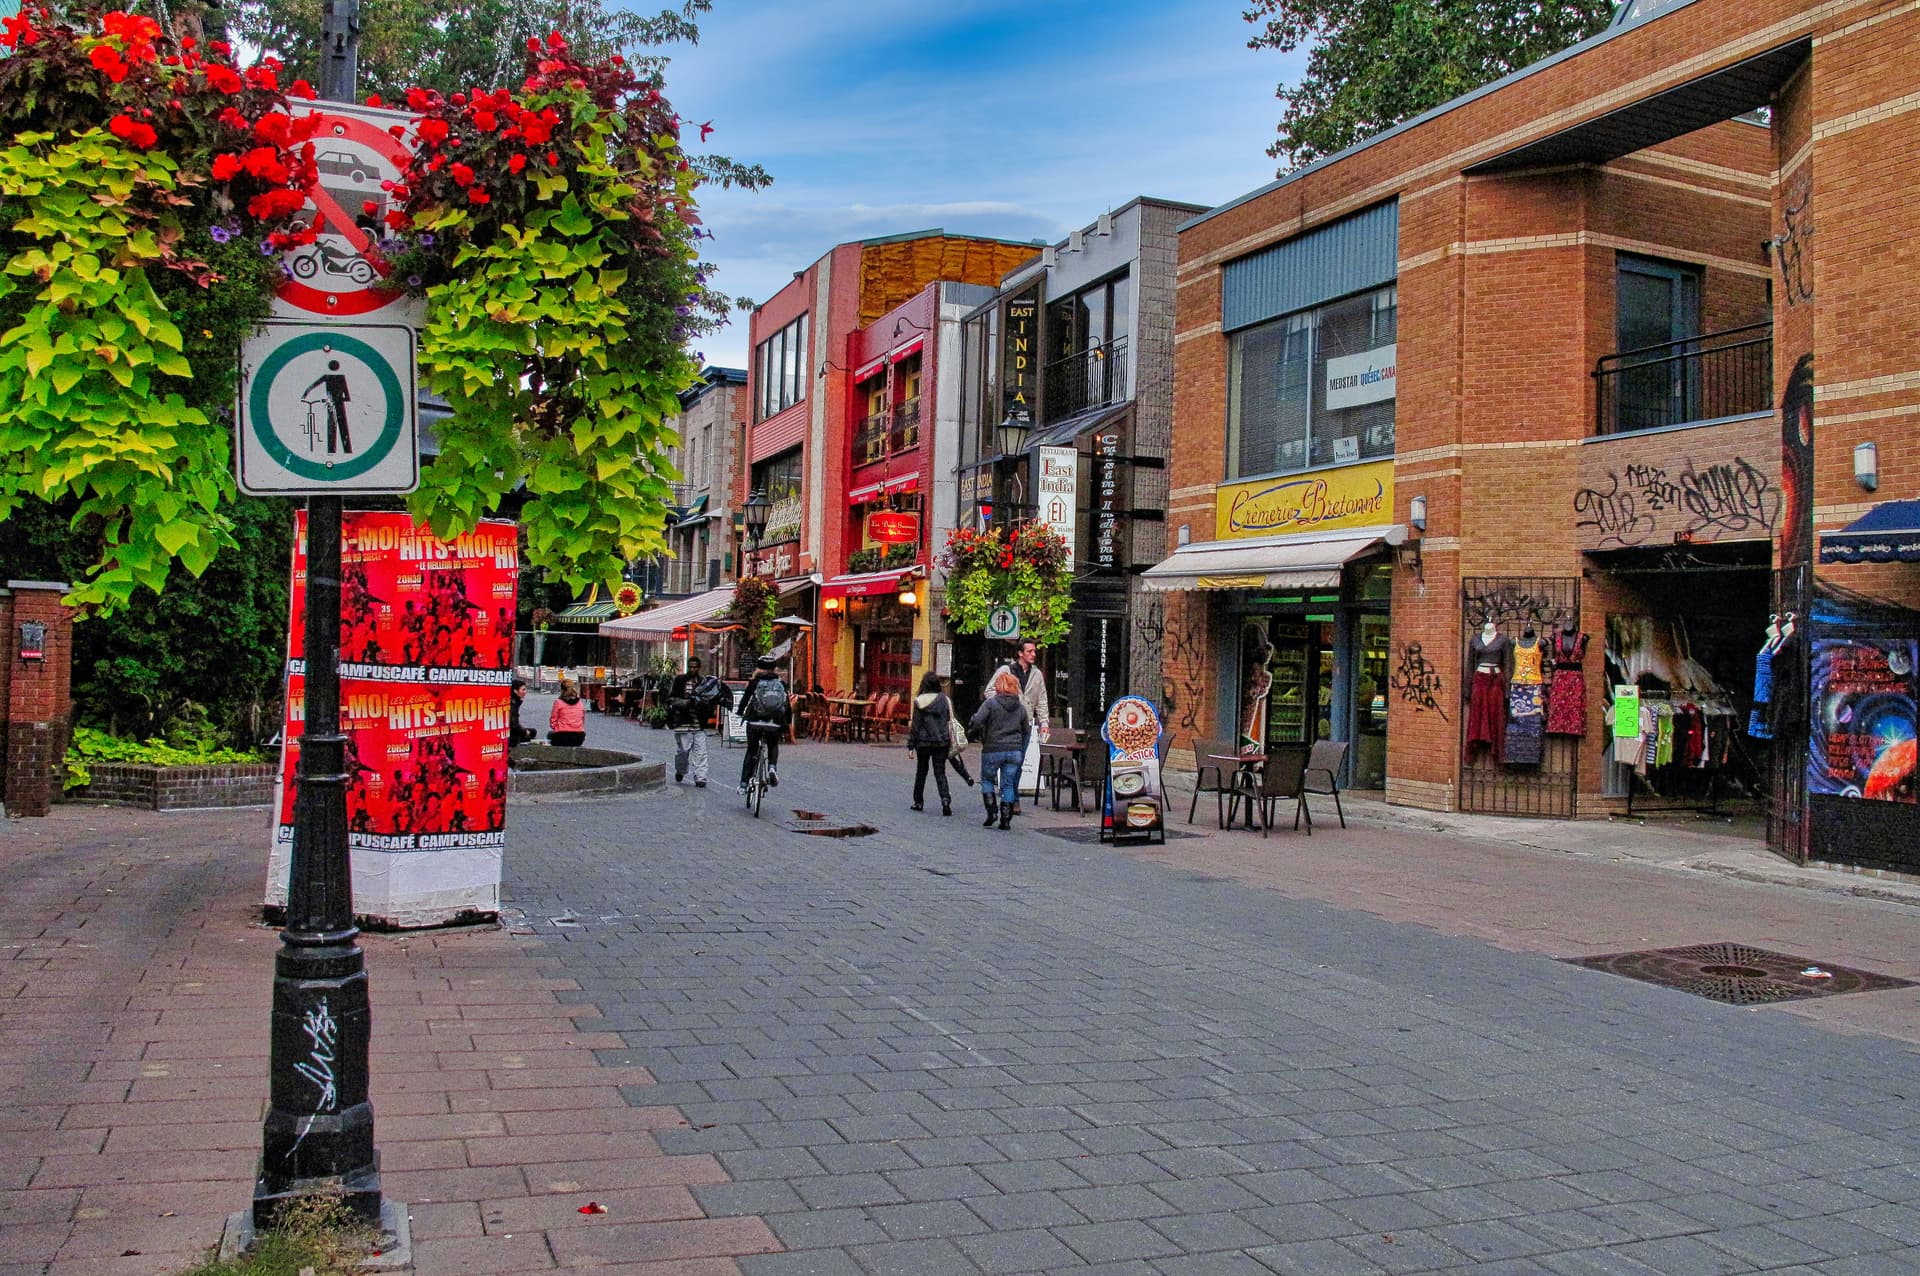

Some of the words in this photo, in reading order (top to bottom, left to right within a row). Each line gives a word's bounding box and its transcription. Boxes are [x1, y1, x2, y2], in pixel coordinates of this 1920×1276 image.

[1010, 307, 1035, 317] EAST
[1015, 320, 1027, 405] INDIA
[1329, 375, 1359, 392] MEDSTAR
[1040, 449, 1076, 458] RESTAURANT
[1041, 457, 1073, 477] East
[1039, 478, 1073, 494] India
[1229, 490, 1293, 532] Crèmerie
[1298, 479, 1383, 525] Bretonne
[399, 534, 495, 561] HITS-MOI
[389, 697, 484, 730] HITS-MOI
